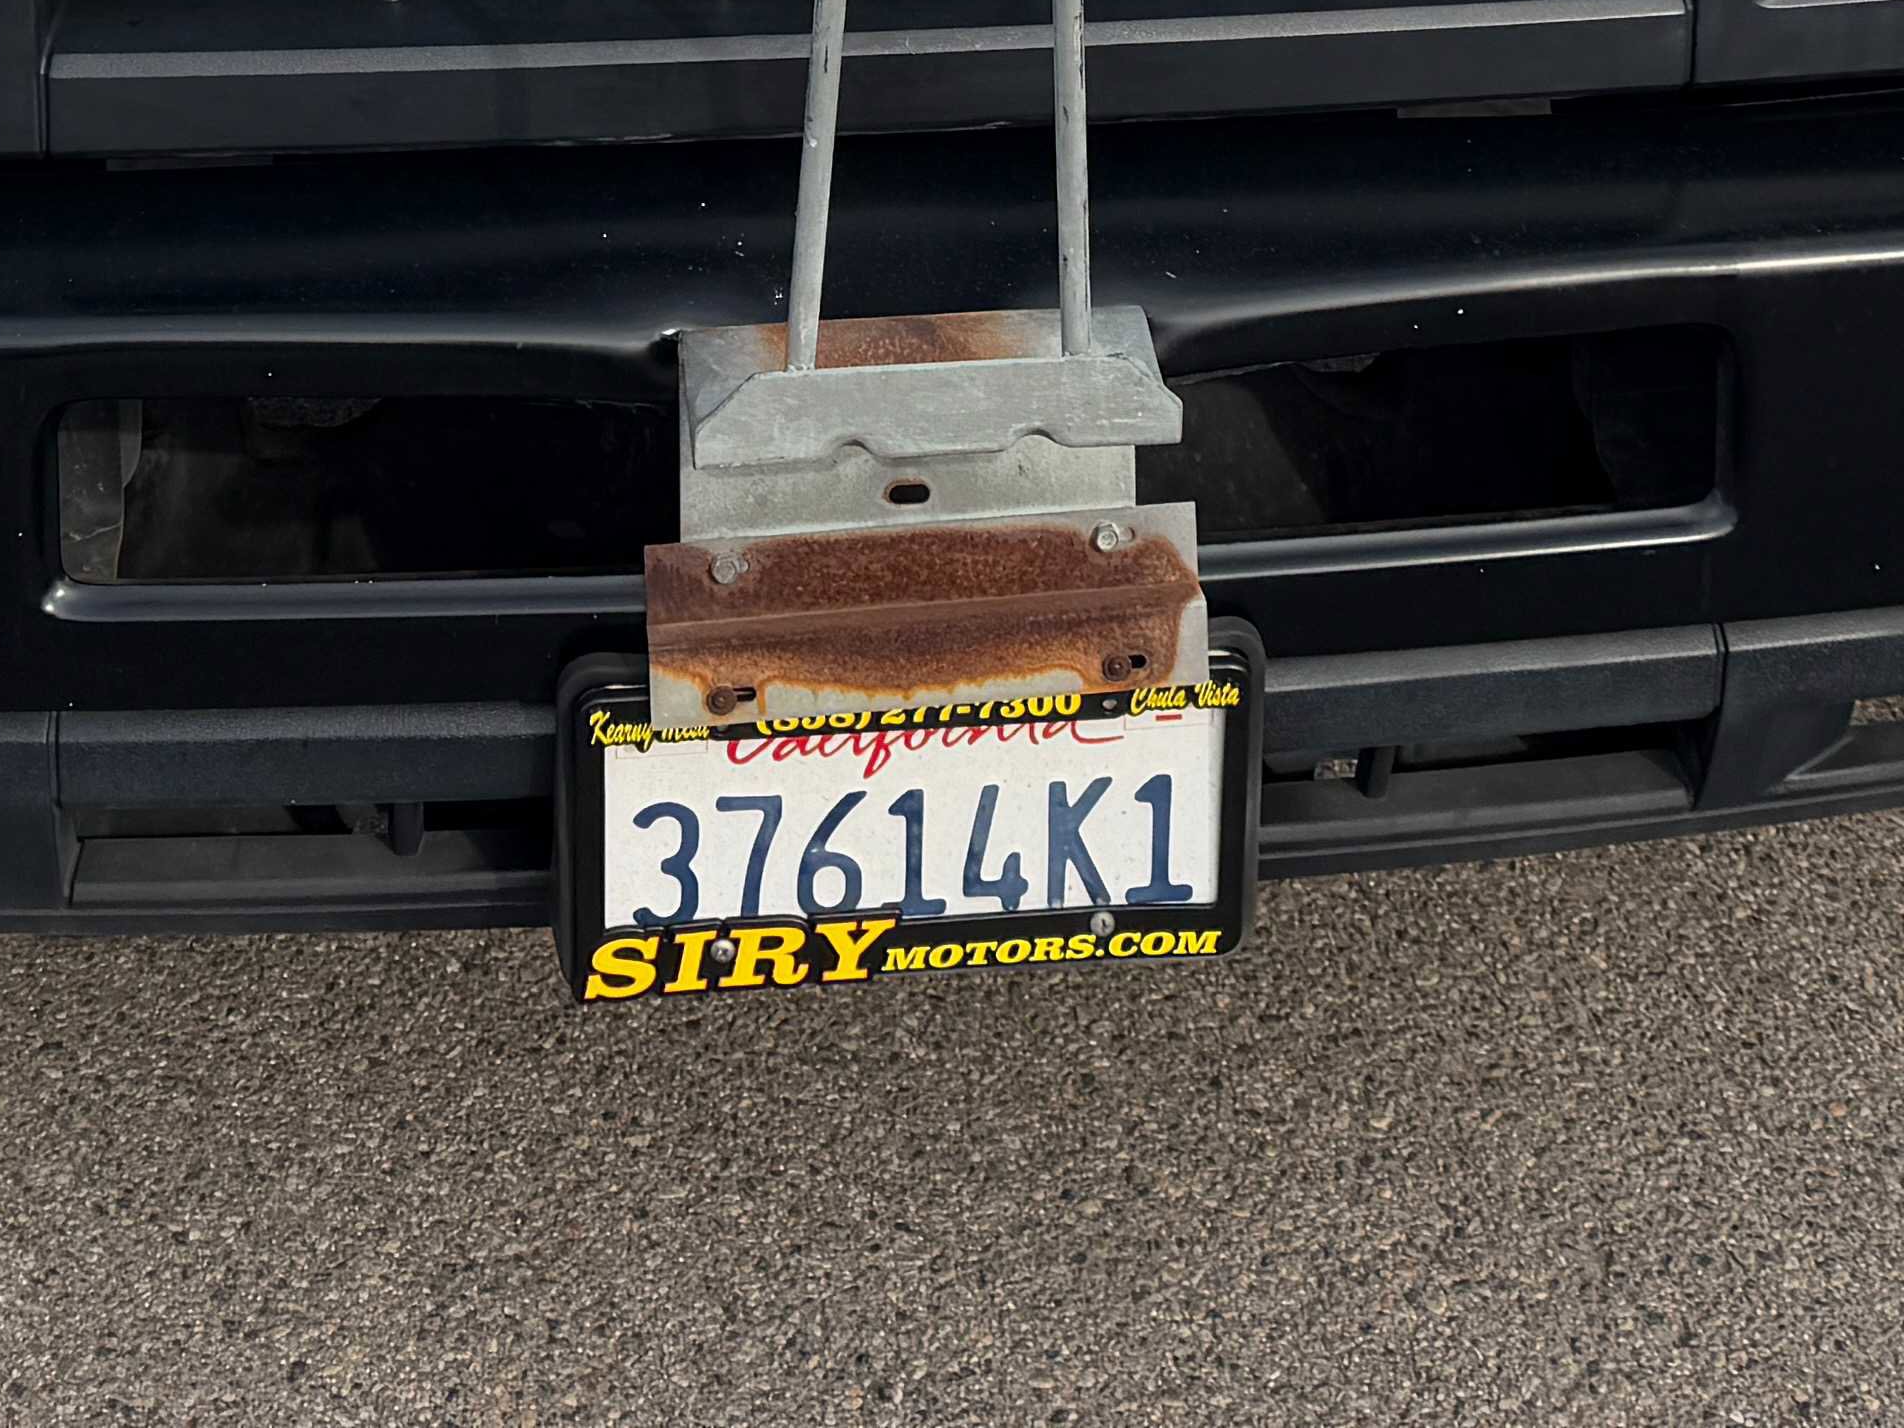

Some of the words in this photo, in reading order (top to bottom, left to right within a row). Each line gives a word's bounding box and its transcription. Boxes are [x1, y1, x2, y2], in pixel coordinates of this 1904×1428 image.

[588, 710, 655, 752] Kearny
[1130, 686, 1186, 716] Chula
[1194, 679, 1241, 709] Vista
[631, 773, 1194, 929] 37614K1
[582, 917, 897, 1000] SIRY
[881, 929, 1222, 973] MOTORS.COM
